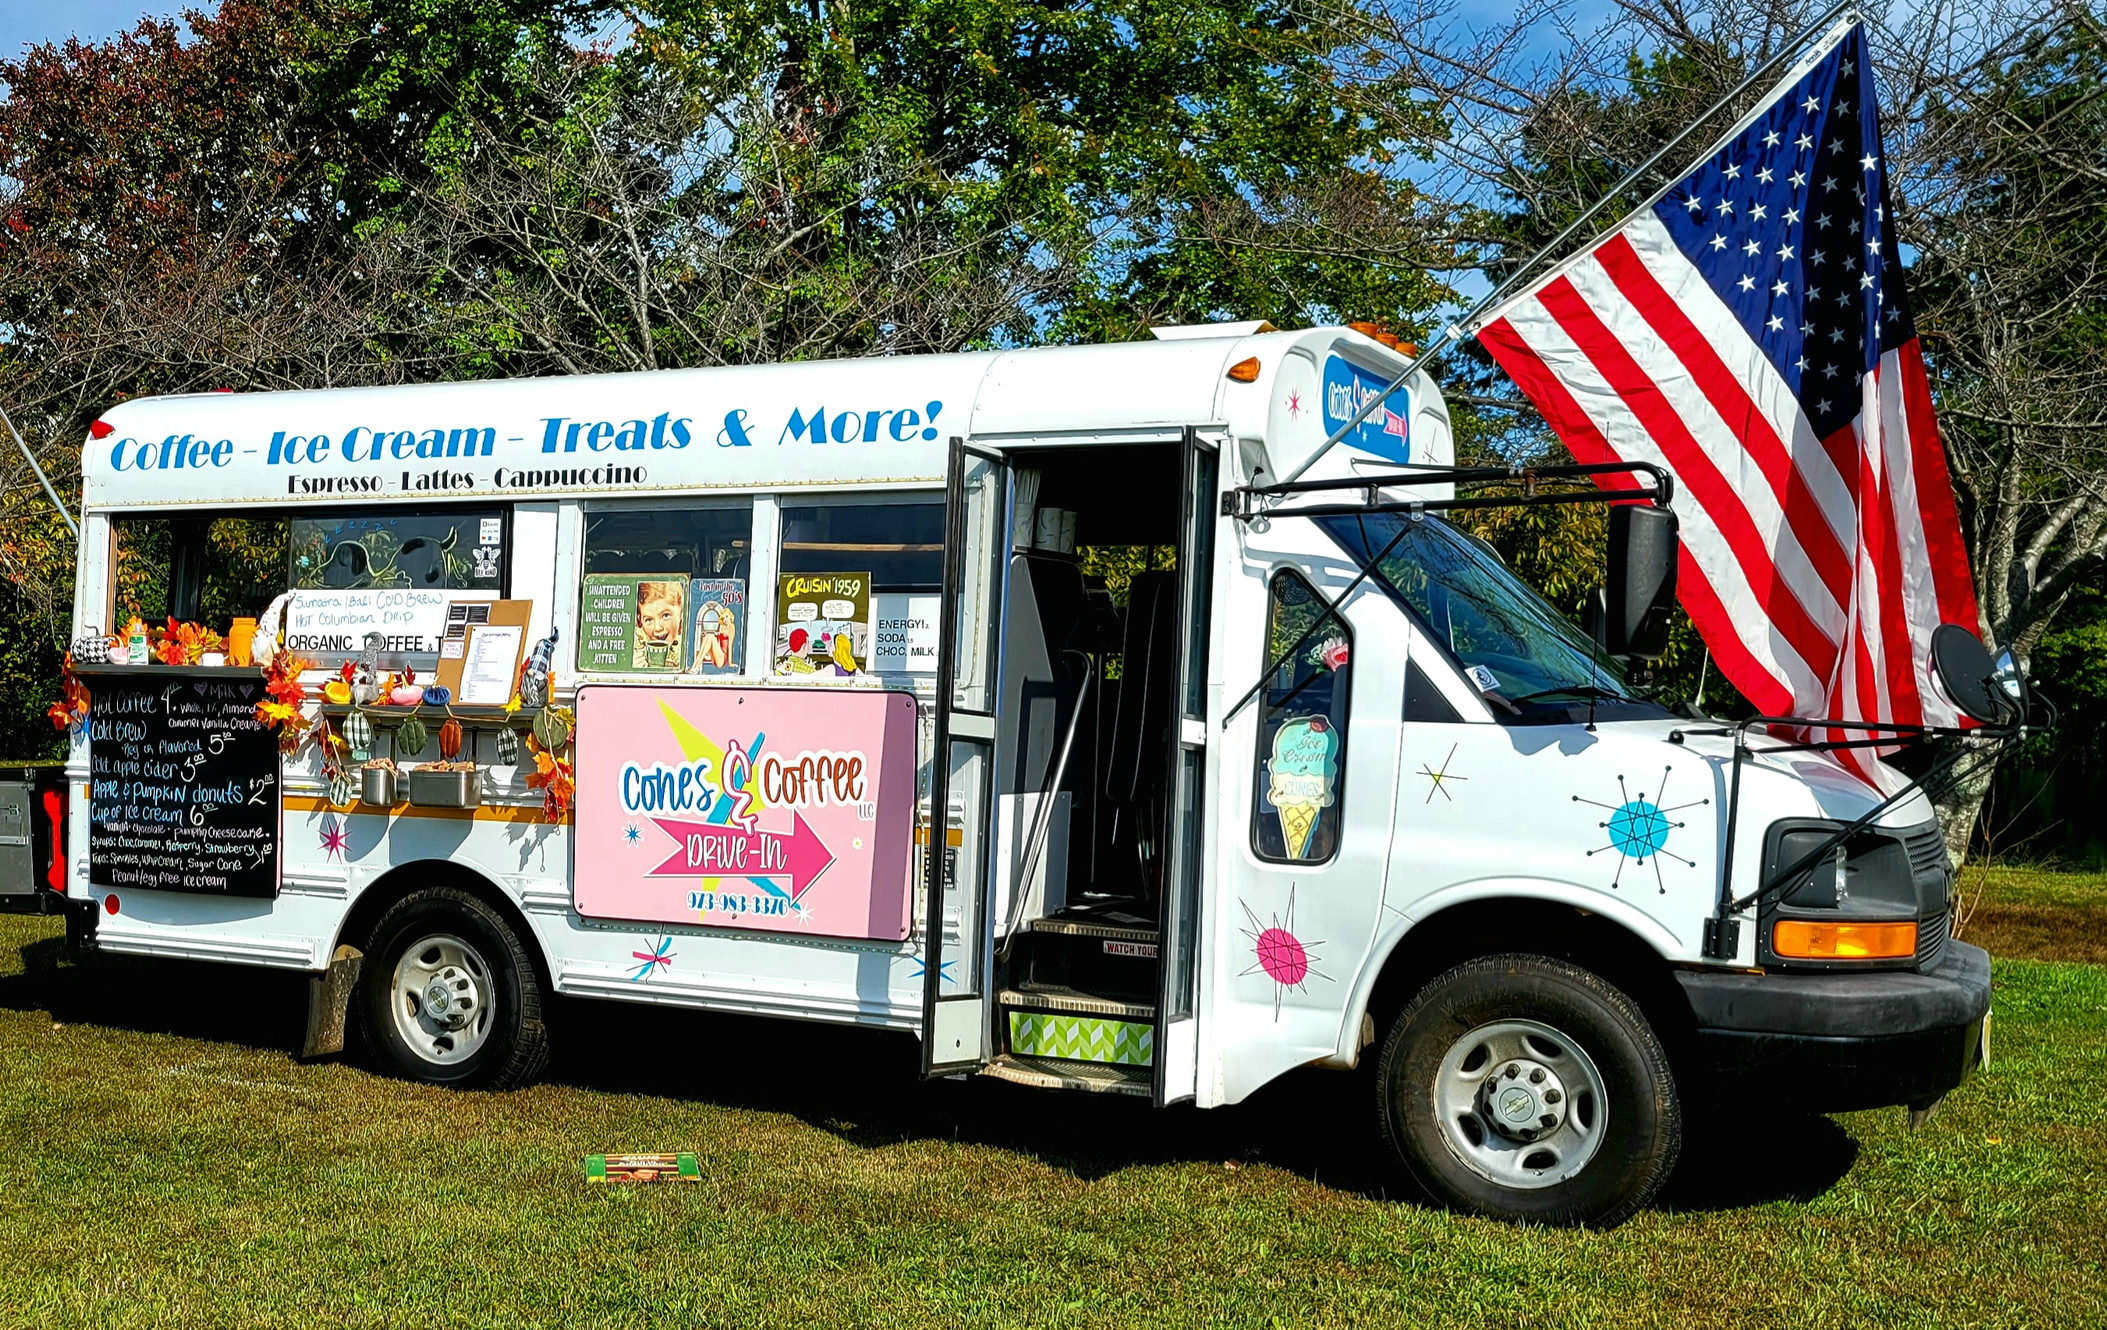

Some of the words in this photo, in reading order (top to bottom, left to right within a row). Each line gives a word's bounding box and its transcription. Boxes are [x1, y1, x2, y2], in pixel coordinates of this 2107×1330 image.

[111, 434, 233, 471] Coffee
[267, 431, 330, 465] Ice
[341, 426, 496, 463] Cream
[540, 411, 693, 453] Treats
[716, 408, 755, 448] &
[778, 400, 943, 446] More!
[288, 475, 383, 494] Espresso
[401, 469, 475, 491] Lattes
[494, 462, 648, 488] Cappuccino
[588, 585, 631, 596] UNATTENDED
[834, 579, 861, 598] 1959
[295, 595, 342, 609] Sumatra
[593, 599, 625, 609] CHILDREN
[318, 611, 375, 627] Columbian
[585, 612, 600, 623] WILL
[602, 612, 611, 623] BE
[611, 612, 632, 623] GIVEN
[878, 619, 925, 629] ENERGY!
[592, 626, 623, 637] ESPRESSO
[877, 633, 906, 643] SODA
[288, 635, 353, 651] ORGANIC
[587, 640, 602, 650] AND
[602, 640, 608, 650] A
[609, 640, 626, 650] FREE
[876, 646, 907, 656] CHOC.
[594, 654, 617, 664] KITTEN
[116, 690, 157, 714] Coffee
[222, 703, 257, 714] Almond
[92, 719, 113, 741] Cold
[168, 718, 199, 728] Caramel
[201, 718, 230, 729] Vanilla
[1282, 749, 1325, 762] Cream
[93, 779, 118, 799] Apple
[192, 780, 243, 804] donuts
[721, 739, 759, 837] &
[763, 756, 864, 804] Coffee
[91, 802, 110, 825] Cup
[91, 835, 117, 849] Syrups:
[204, 842, 255, 856] Strawberry
[187, 857, 215, 873] Sugar
[216, 857, 243, 871] Cone
[687, 891, 789, 916] 973-983-3376
[1106, 943, 1135, 954] WATCH
[1136, 945, 1158, 957] YOUR
